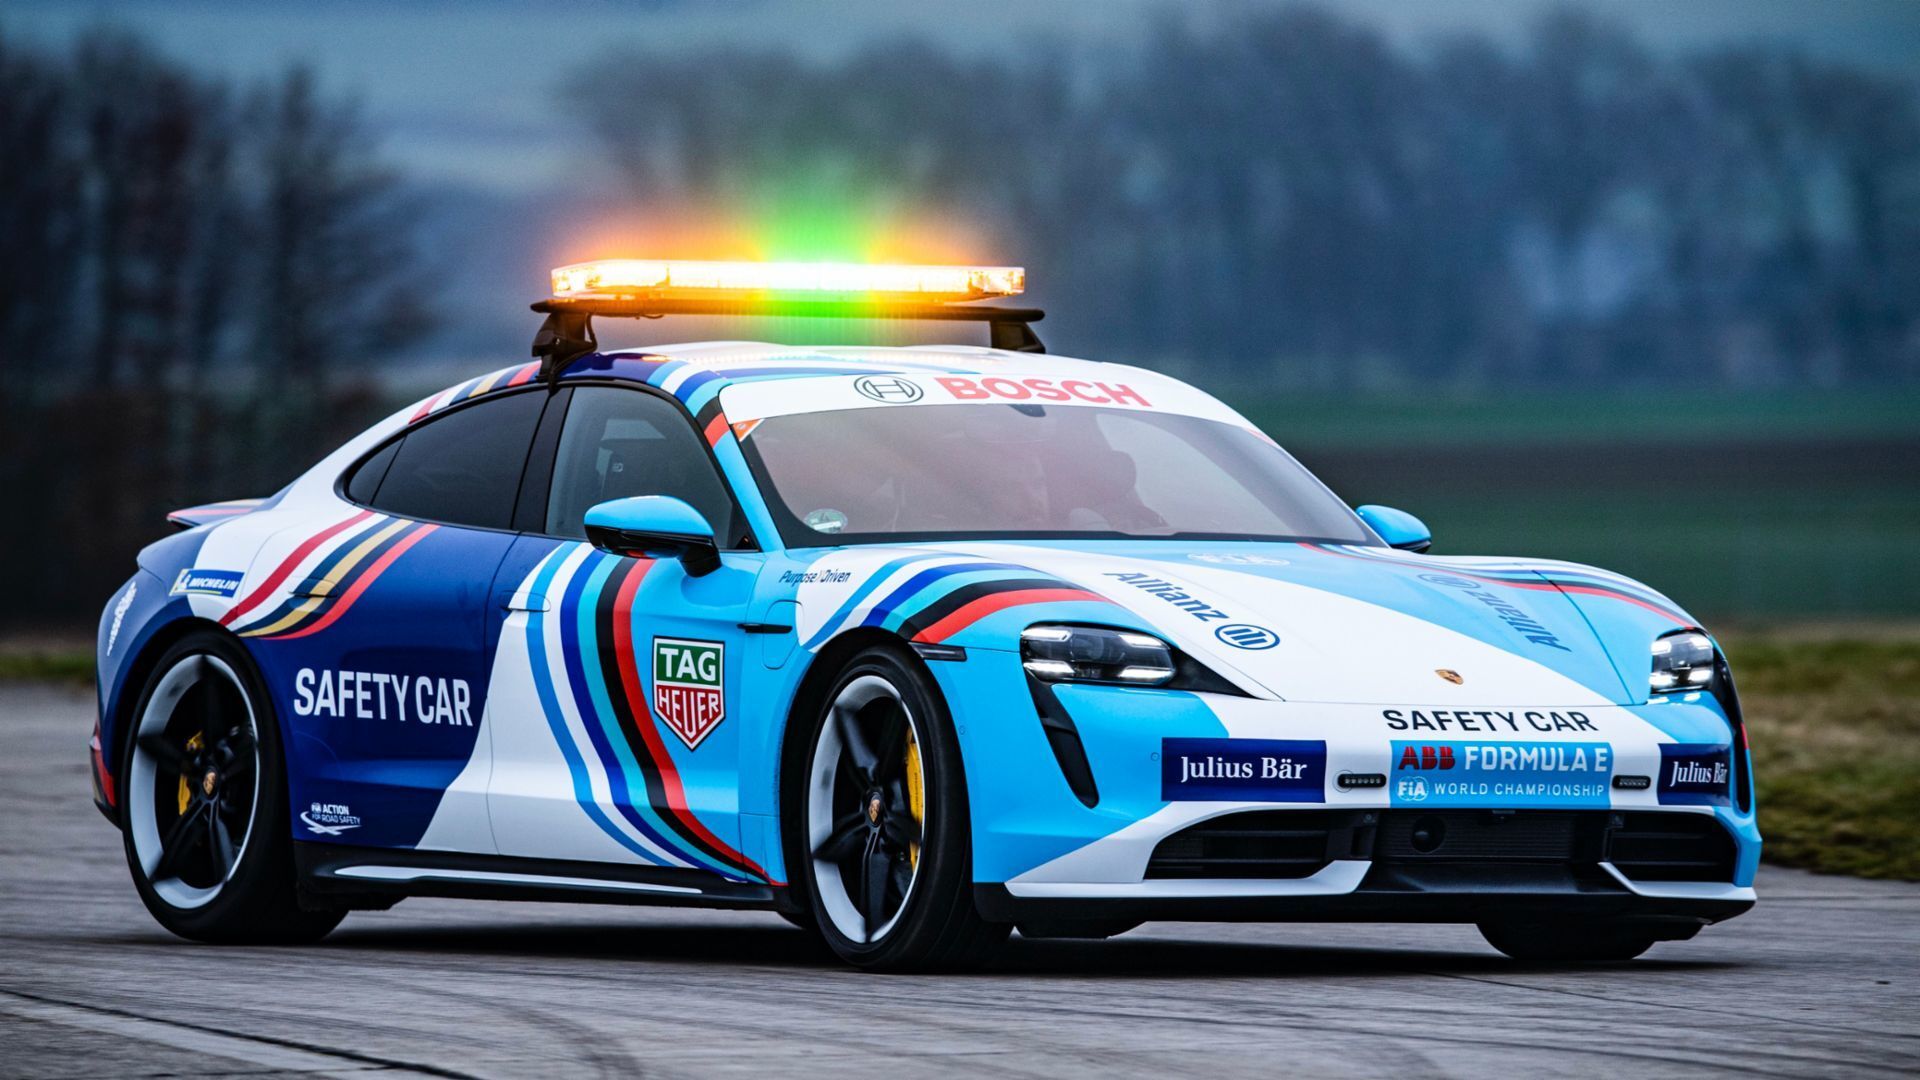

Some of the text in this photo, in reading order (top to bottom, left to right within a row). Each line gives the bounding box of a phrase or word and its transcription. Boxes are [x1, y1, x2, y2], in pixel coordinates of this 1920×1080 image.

[934, 377, 1152, 407] BOSCH
[189, 578, 239, 590] MICHELIN
[778, 570, 818, 587] Purpose
[1102, 572, 1229, 622] Allianz
[1463, 589, 1573, 652] Allianz
[659, 647, 717, 681] TAG
[293, 667, 474, 727] SAFETY CAR
[658, 688, 719, 739] HEUER
[1382, 709, 1600, 732] SAFETY CAR
[1180, 756, 1308, 783] Julius Bär
[1398, 746, 1608, 772] ABB FORMULA E
[1669, 760, 1713, 788] Julius
[1434, 783, 1488, 795] WORLD
[1494, 783, 1605, 796] CHAMPIONSHIP
[321, 814, 339, 823] ROAD
[339, 815, 361, 825] SAFETY
[323, 804, 349, 815] ACTION
